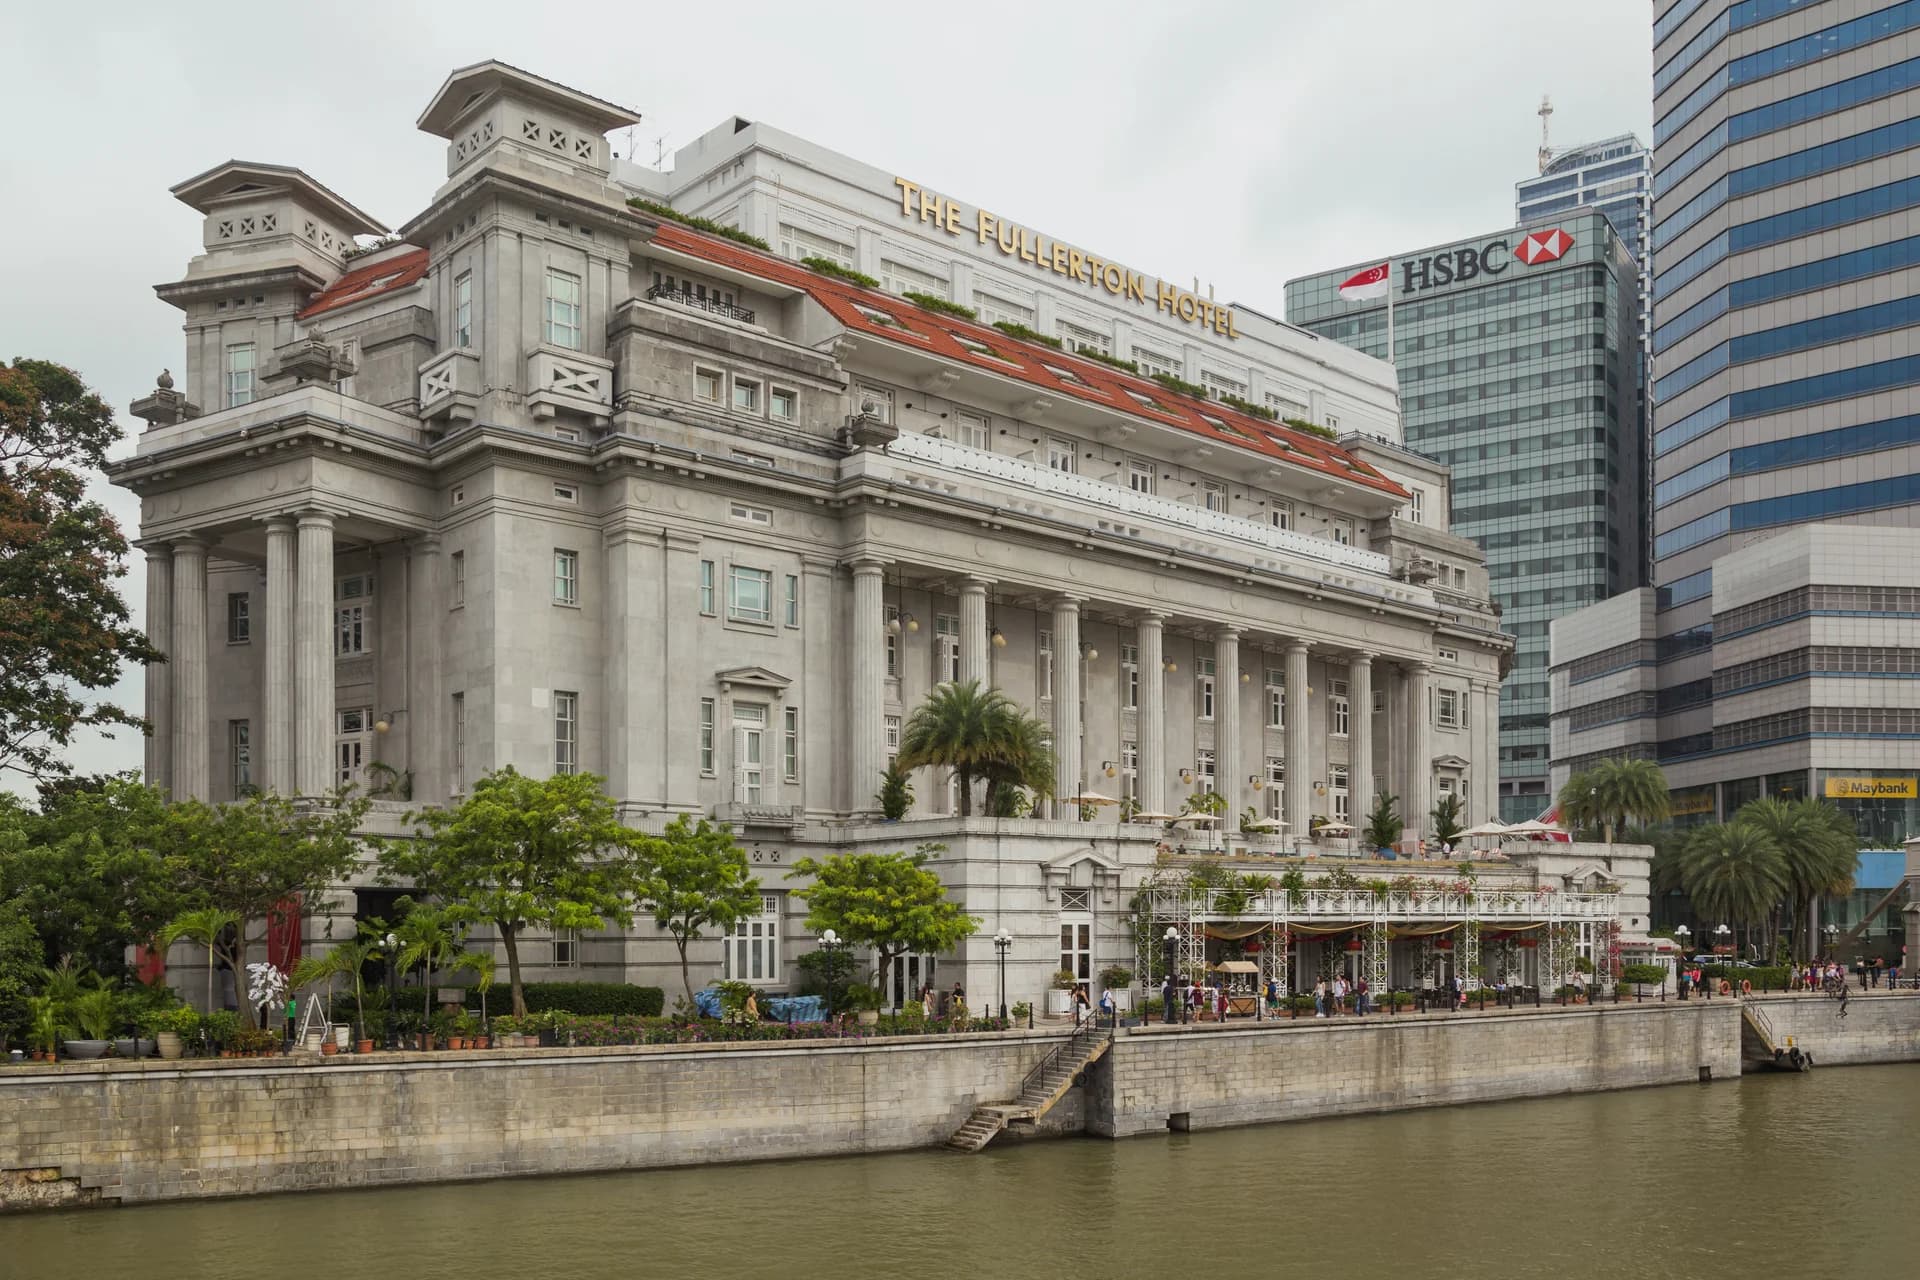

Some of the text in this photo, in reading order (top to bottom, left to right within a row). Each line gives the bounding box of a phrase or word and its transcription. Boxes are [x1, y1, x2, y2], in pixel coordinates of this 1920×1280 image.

[895, 176, 1240, 339] THE FULLERTON HOTEL
[1401, 239, 1509, 293] HSBC
[1851, 782, 1909, 796] Maybank
